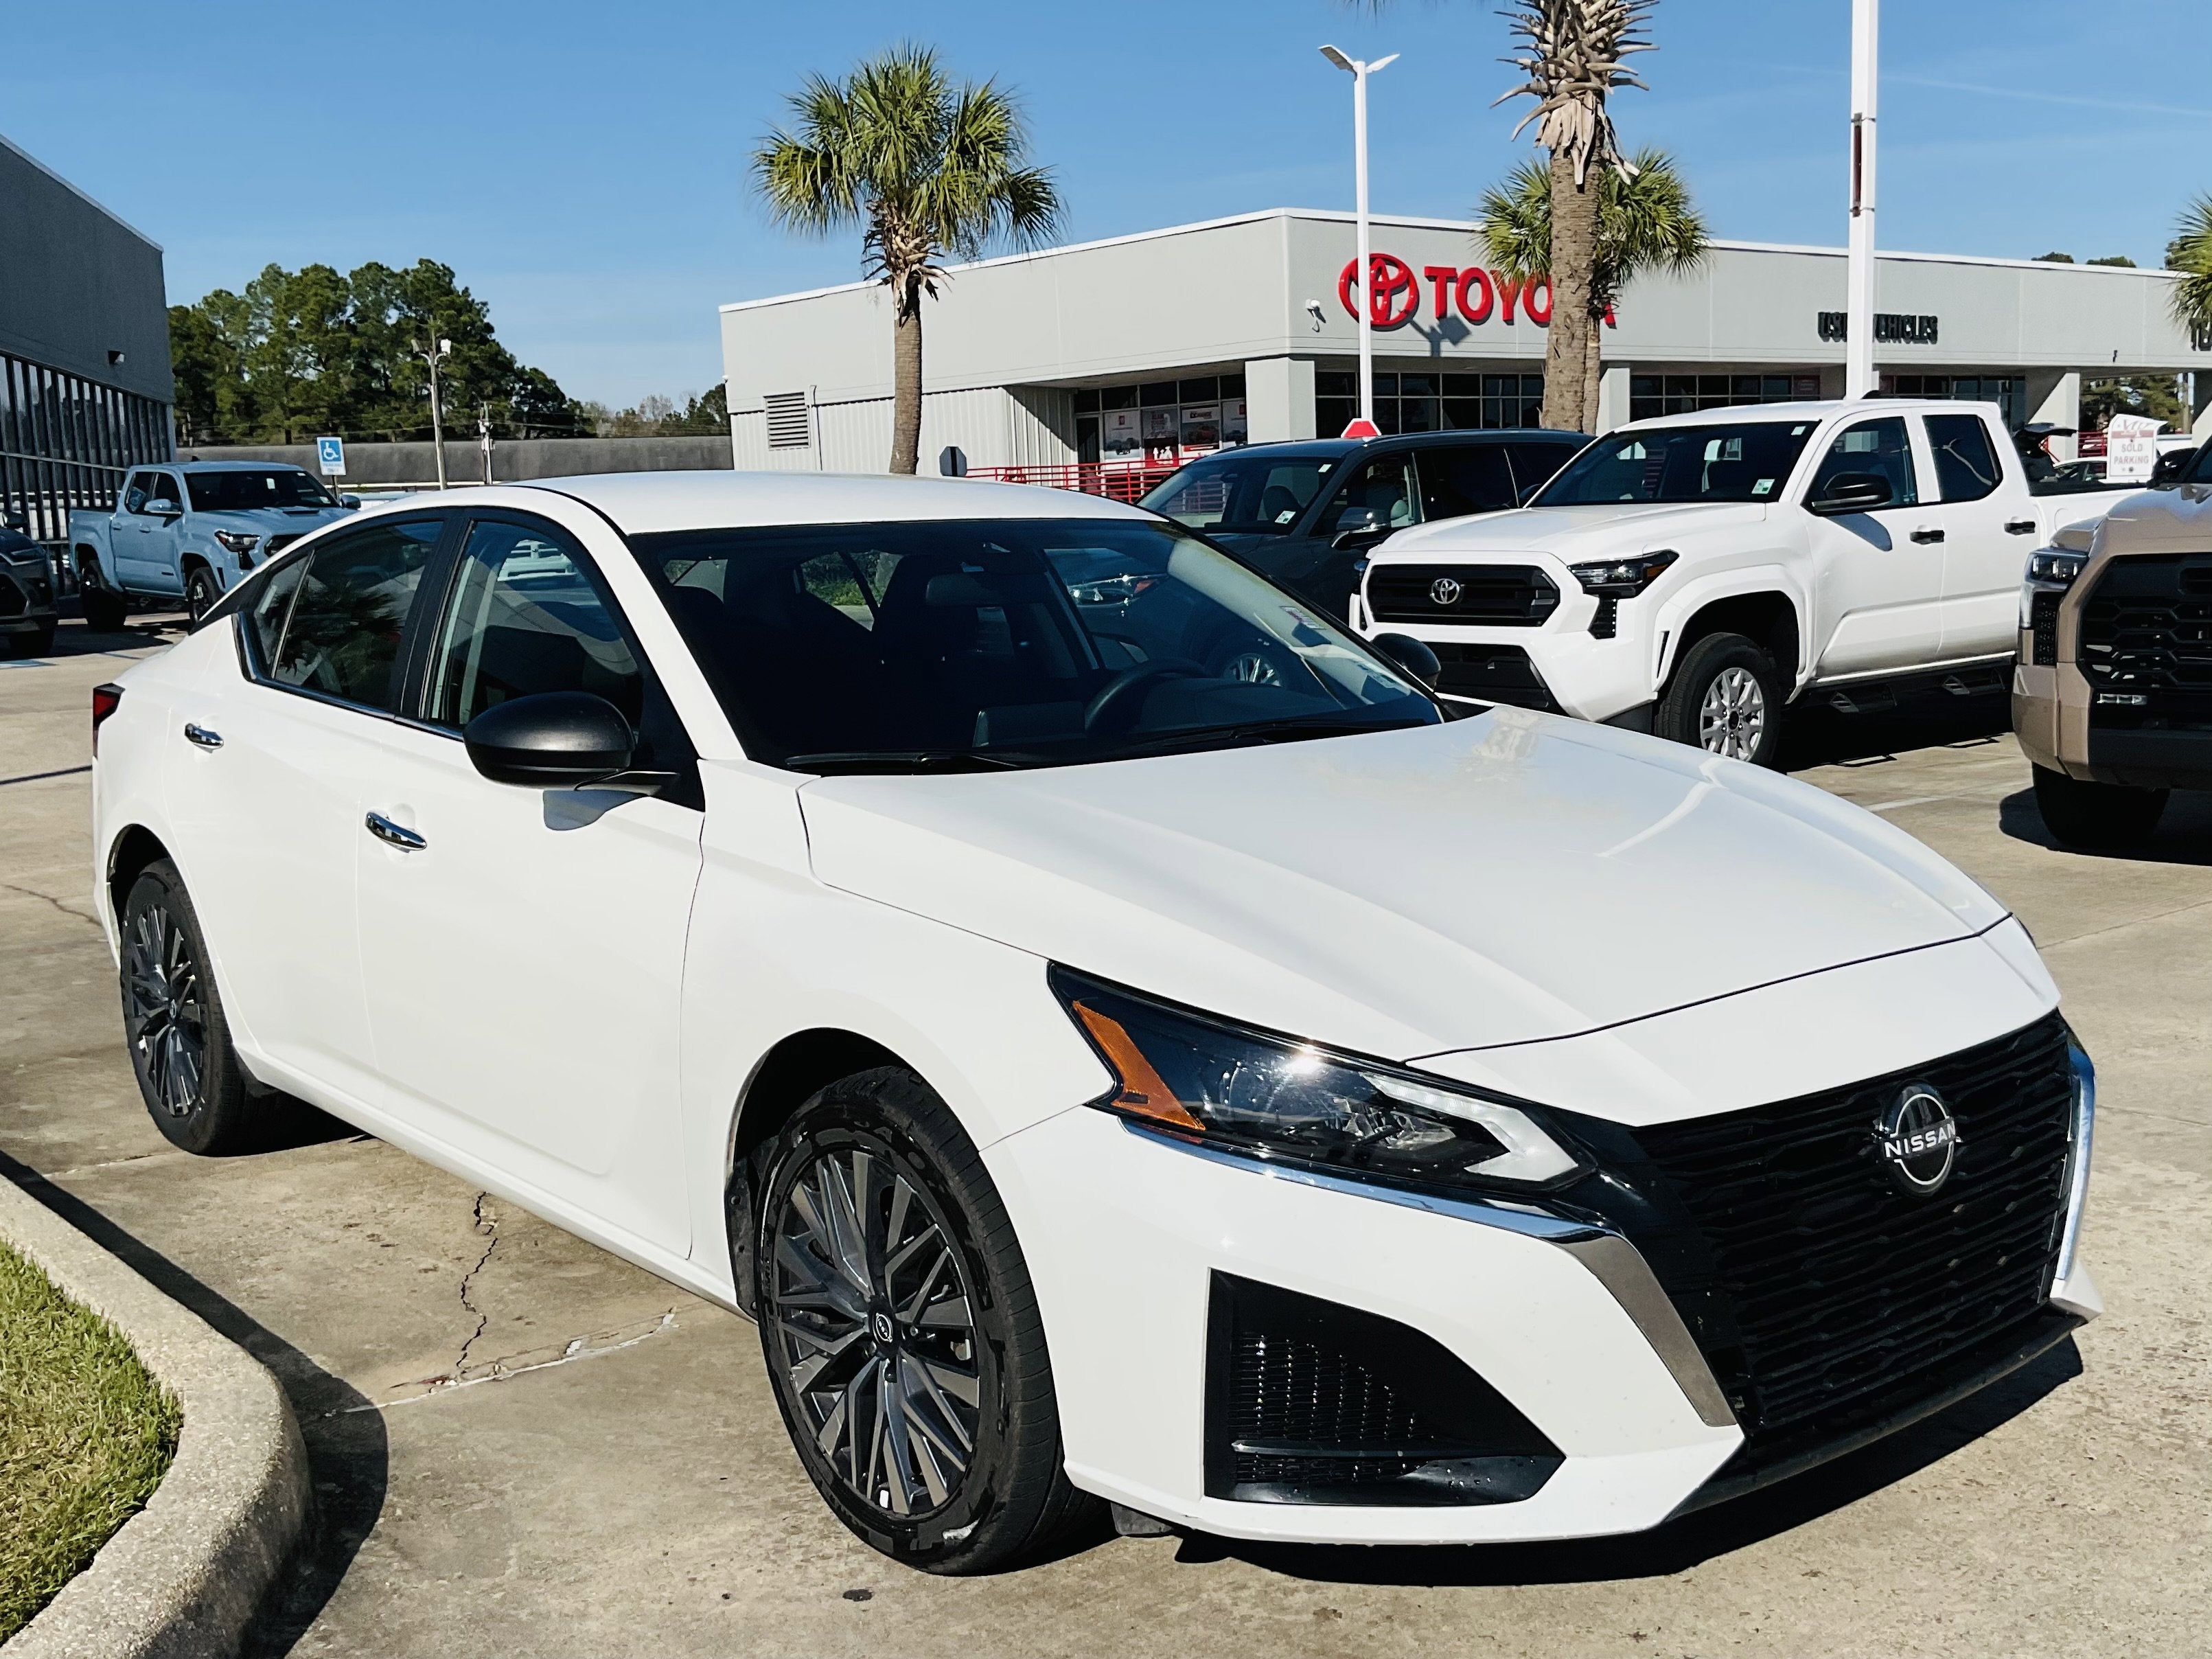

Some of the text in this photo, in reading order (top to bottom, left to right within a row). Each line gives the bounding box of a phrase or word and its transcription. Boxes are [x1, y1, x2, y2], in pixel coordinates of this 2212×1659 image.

[1425, 266, 1617, 329] TOYO
[1818, 312, 1848, 343] US
[2114, 455, 2150, 465] PARKING
[2121, 443, 2143, 453] SOLD
[1884, 1120, 1956, 1158] NISSAN
